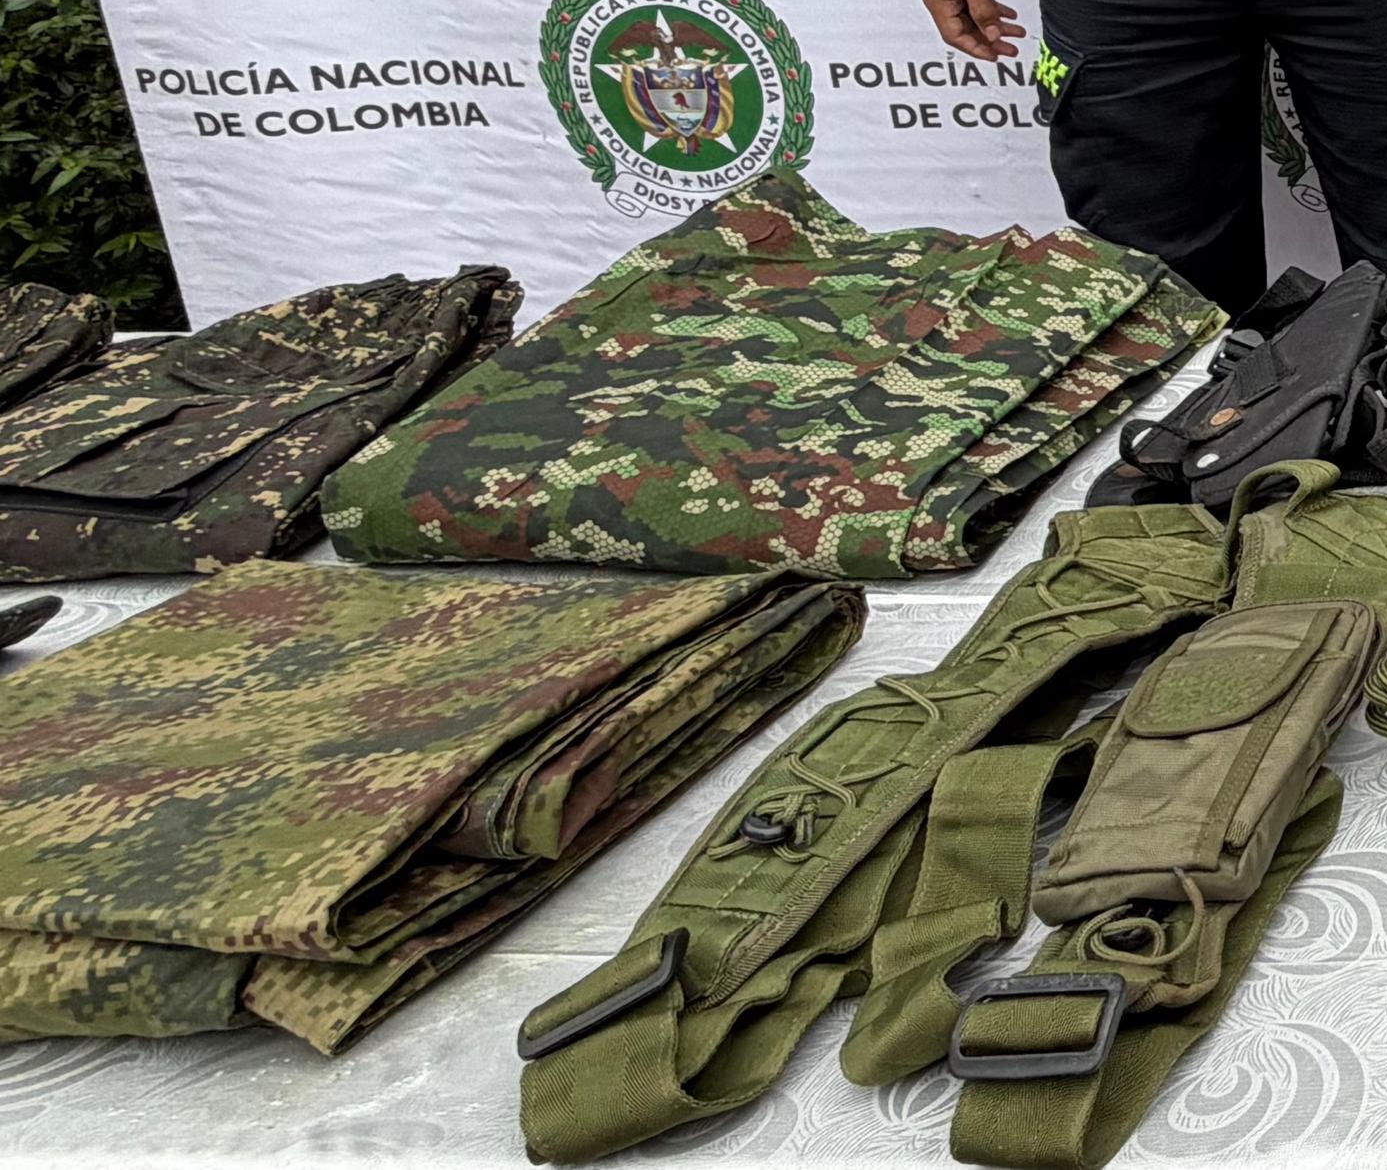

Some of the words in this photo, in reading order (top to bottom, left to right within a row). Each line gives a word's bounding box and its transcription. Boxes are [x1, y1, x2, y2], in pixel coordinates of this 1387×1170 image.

[698, 0, 780, 103] COLOMBIA
[136, 62, 299, 95] POLICÍA
[311, 60, 525, 90] NACIONAL
[830, 52, 988, 88] POLICÍA
[194, 112, 246, 137] DE
[256, 102, 489, 136] COLOMBIA
[890, 104, 941, 128] DE
[697, 128, 778, 188] NACIONAL
[633, 182, 683, 210] DIOS
[683, 197, 696, 211] Y
